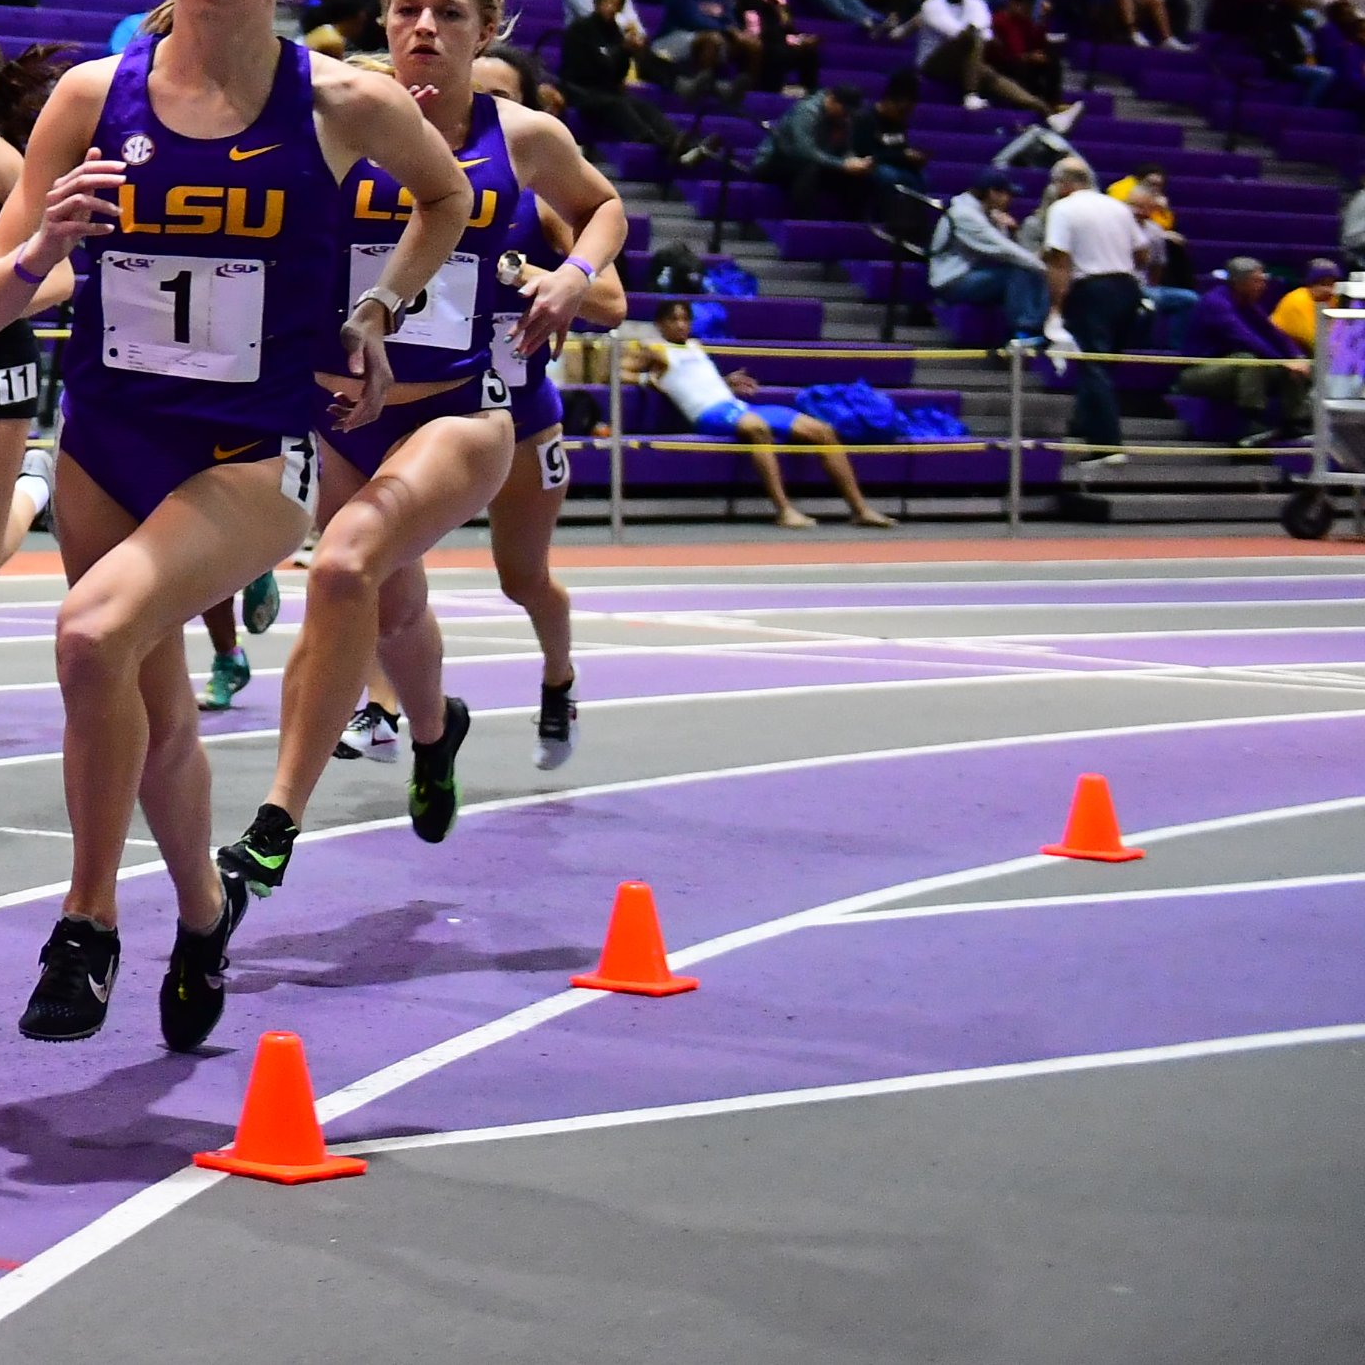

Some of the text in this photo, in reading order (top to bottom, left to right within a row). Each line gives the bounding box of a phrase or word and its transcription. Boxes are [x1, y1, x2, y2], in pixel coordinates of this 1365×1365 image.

[118, 184, 285, 238] LSU
[160, 270, 192, 343] 1
[1, 366, 29, 401] 11
[290, 436, 314, 502] 1
[545, 441, 566, 483] 9
